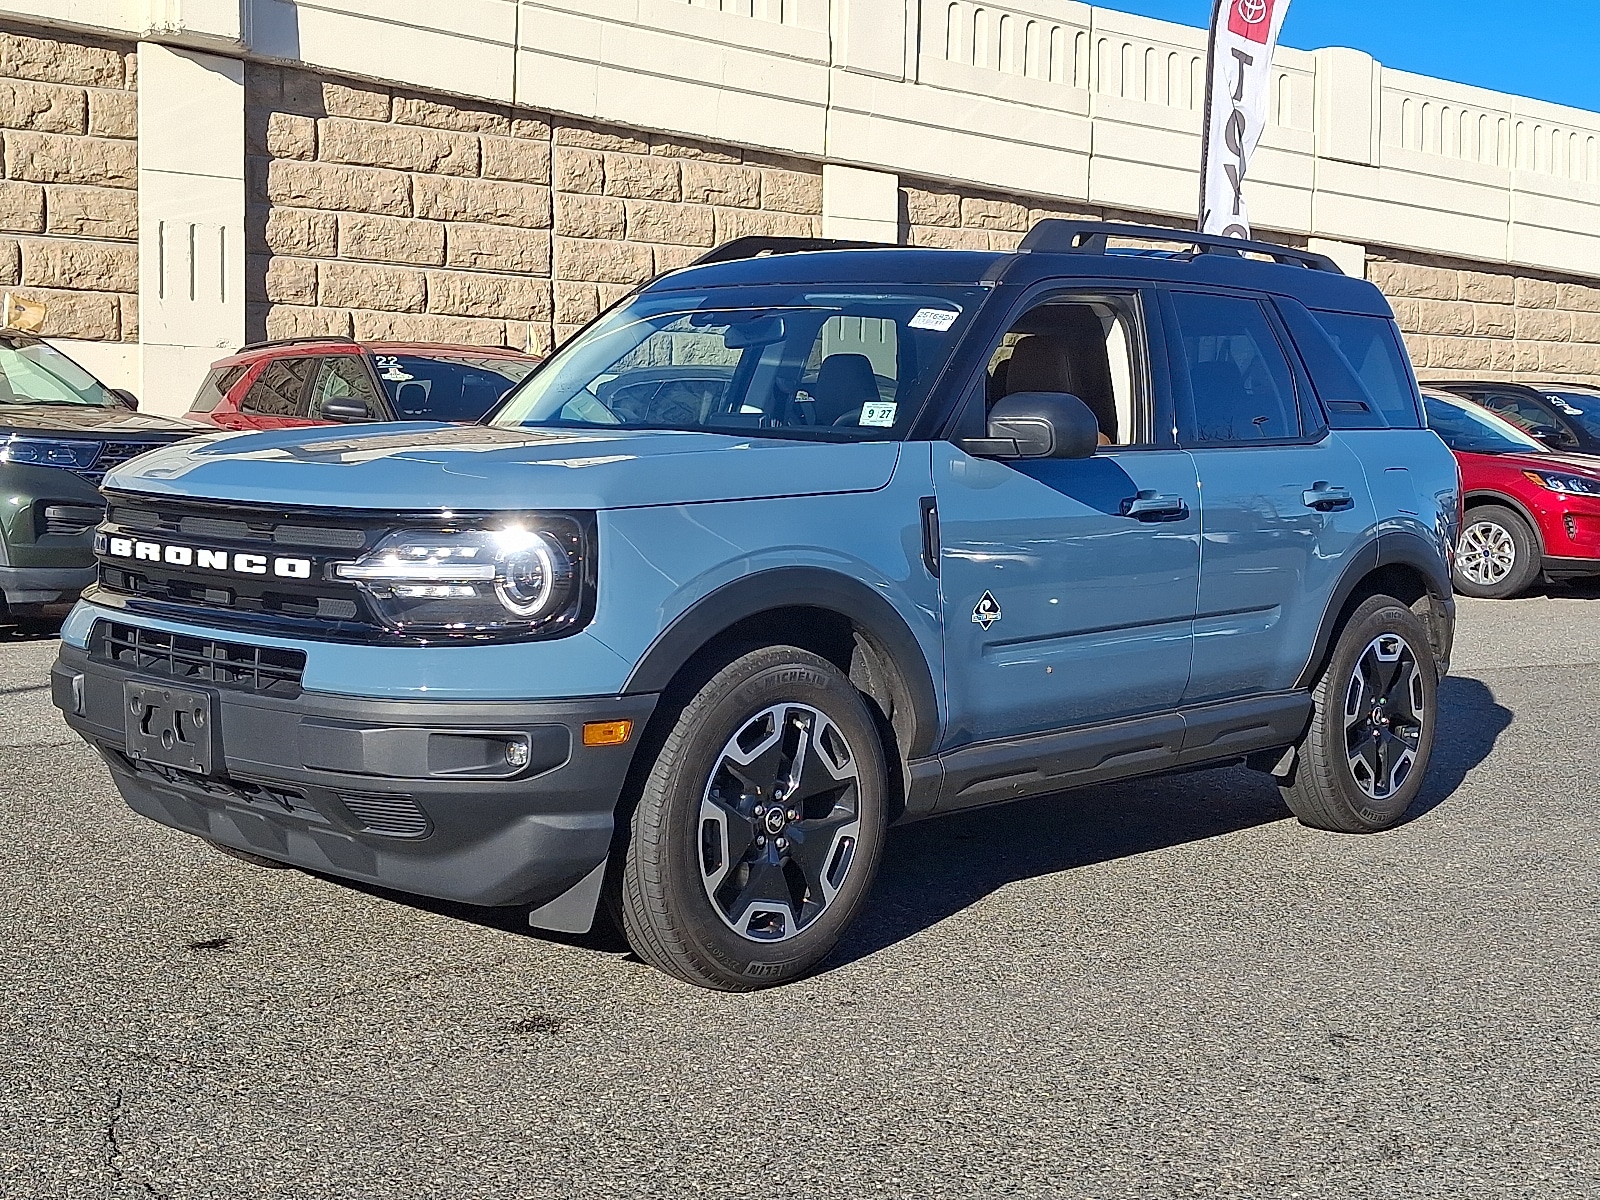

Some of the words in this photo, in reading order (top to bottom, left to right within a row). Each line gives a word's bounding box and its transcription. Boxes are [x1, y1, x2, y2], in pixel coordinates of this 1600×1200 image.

[375, 355, 398, 366] 22
[867, 408, 875, 419] 9
[879, 409, 892, 419] 27
[110, 537, 311, 579] BRONCO
[763, 670, 827, 687] MICHELIN
